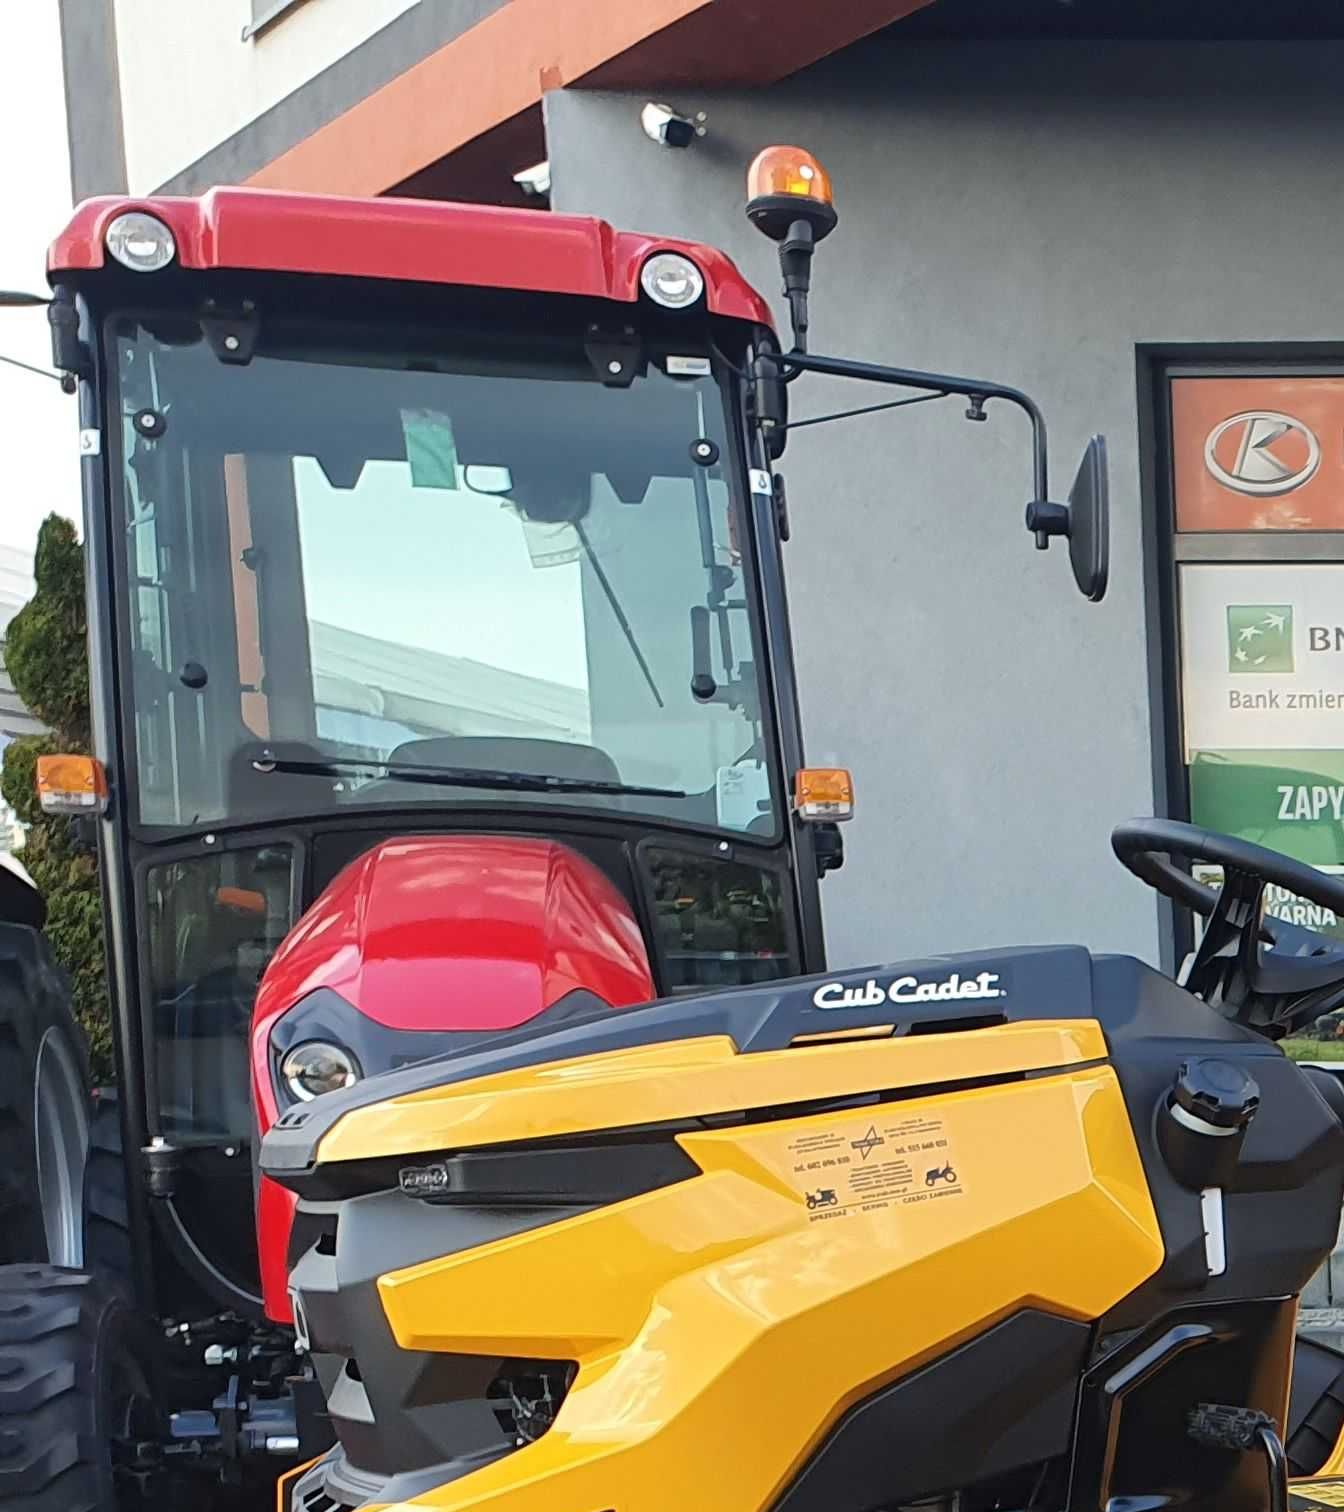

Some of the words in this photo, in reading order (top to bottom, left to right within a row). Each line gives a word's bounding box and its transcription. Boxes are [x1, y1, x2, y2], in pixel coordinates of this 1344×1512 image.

[1228, 689, 1280, 709] Bank
[813, 980, 886, 1009] Cub
[888, 972, 1000, 1004] Cadet
